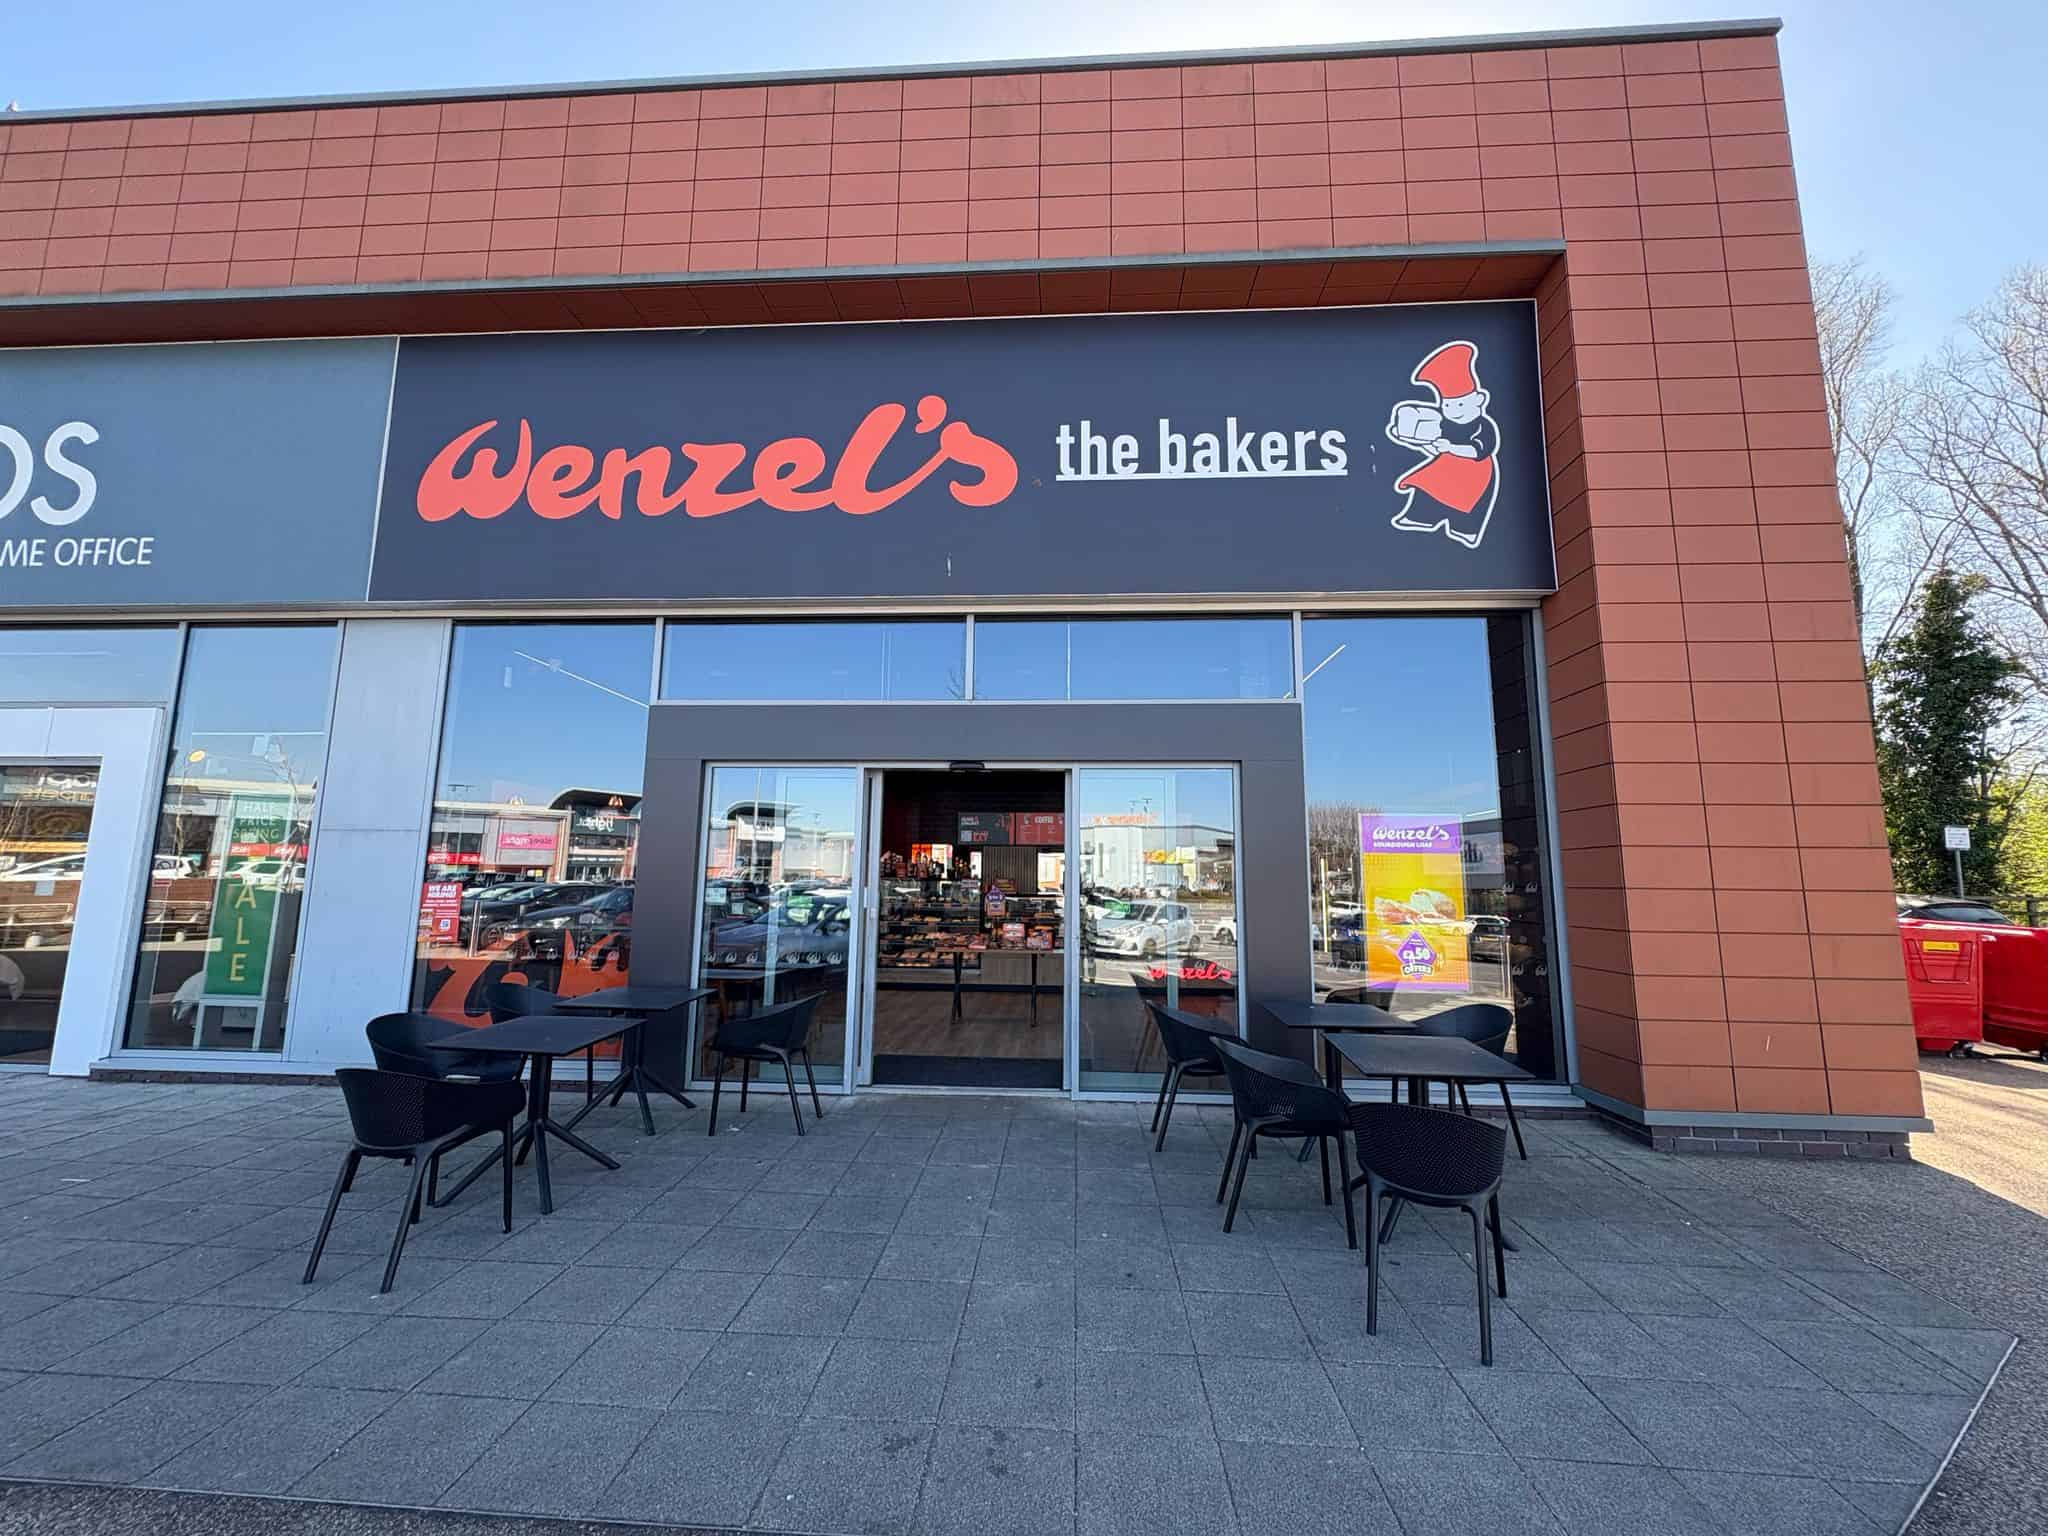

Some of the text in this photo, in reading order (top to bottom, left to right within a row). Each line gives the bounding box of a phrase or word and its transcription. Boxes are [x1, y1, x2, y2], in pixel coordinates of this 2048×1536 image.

[1056, 416, 1348, 475] the bakers
[54, 537, 154, 566] OFFICE
[229, 879, 257, 982] ALE
